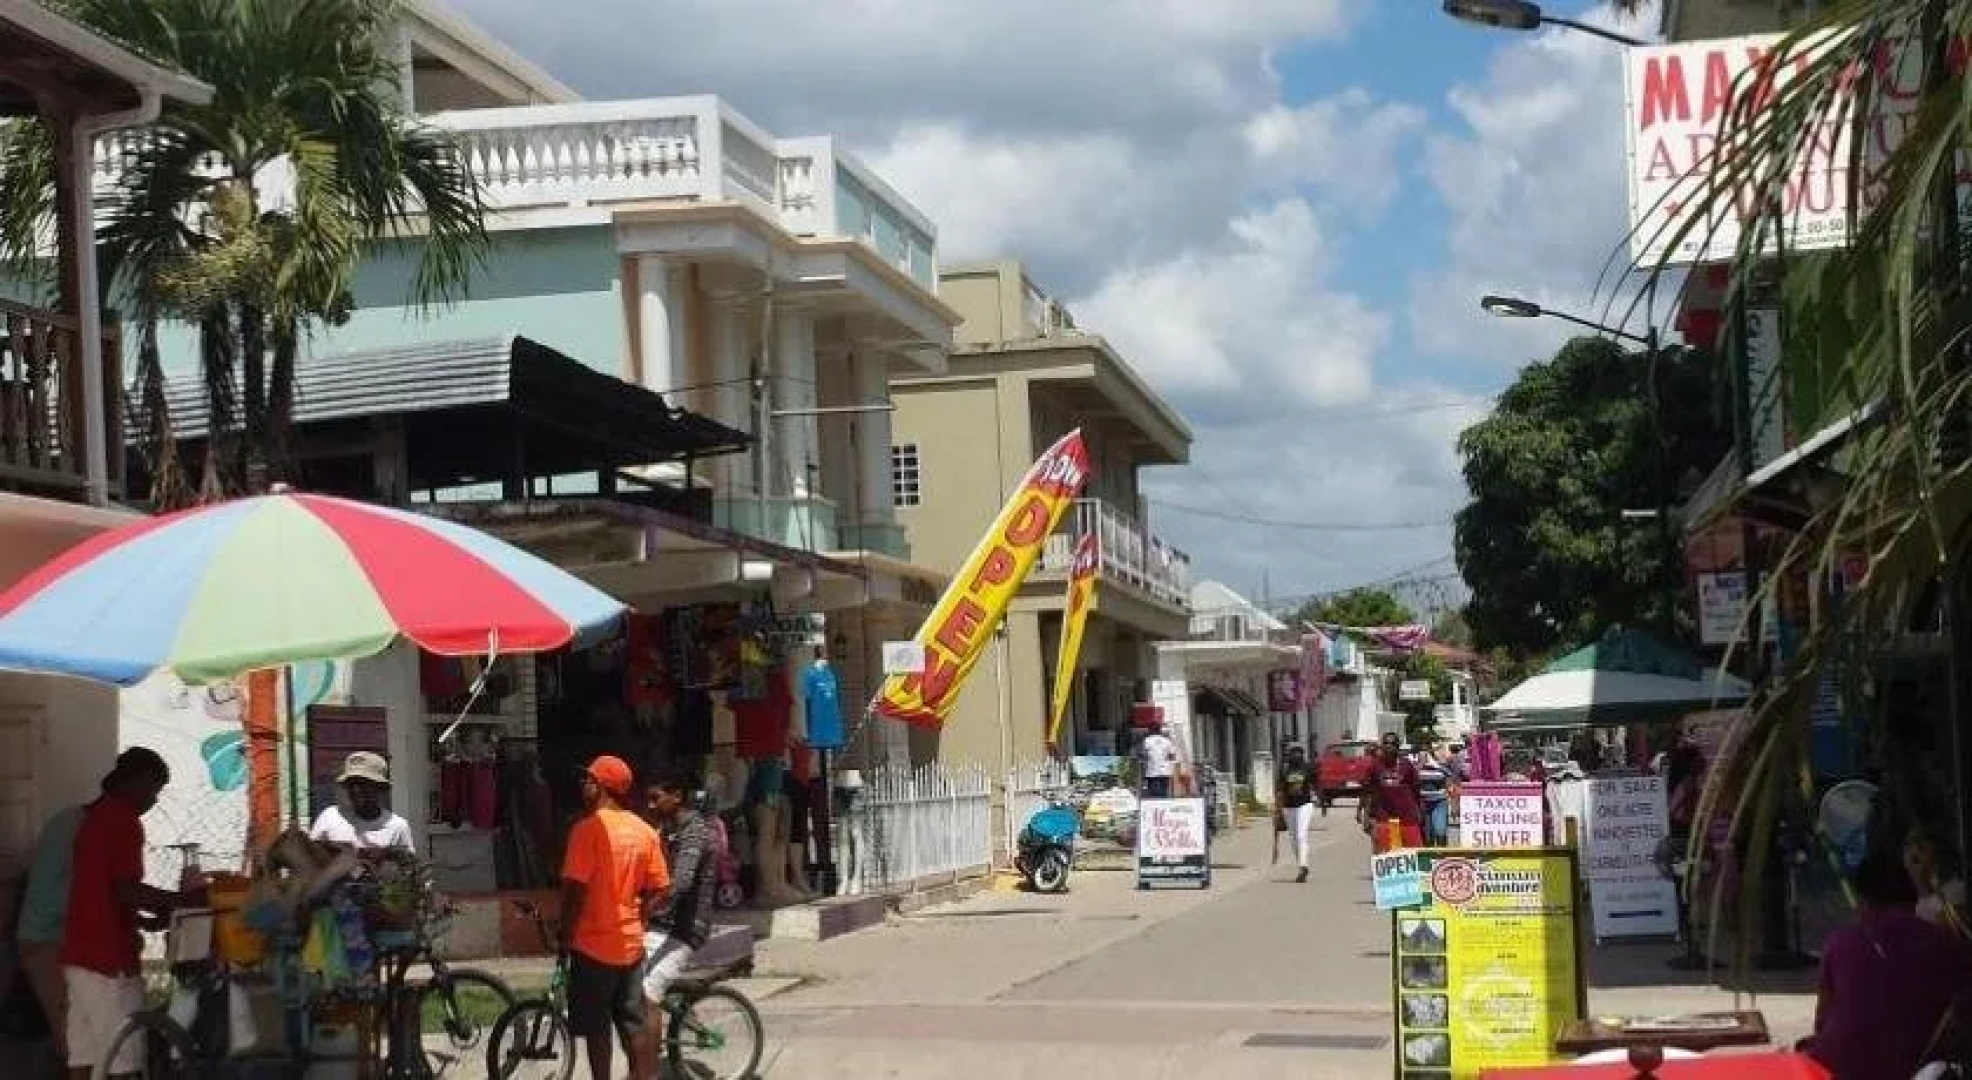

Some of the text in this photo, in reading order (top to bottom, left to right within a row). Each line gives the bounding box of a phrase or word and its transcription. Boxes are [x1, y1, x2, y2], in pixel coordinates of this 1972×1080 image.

[1475, 797, 1527, 809] TAXCO
[1462, 811, 1540, 824] STERLING
[1471, 829, 1532, 845] SILVER
[1375, 854, 1417, 878] OPEN
